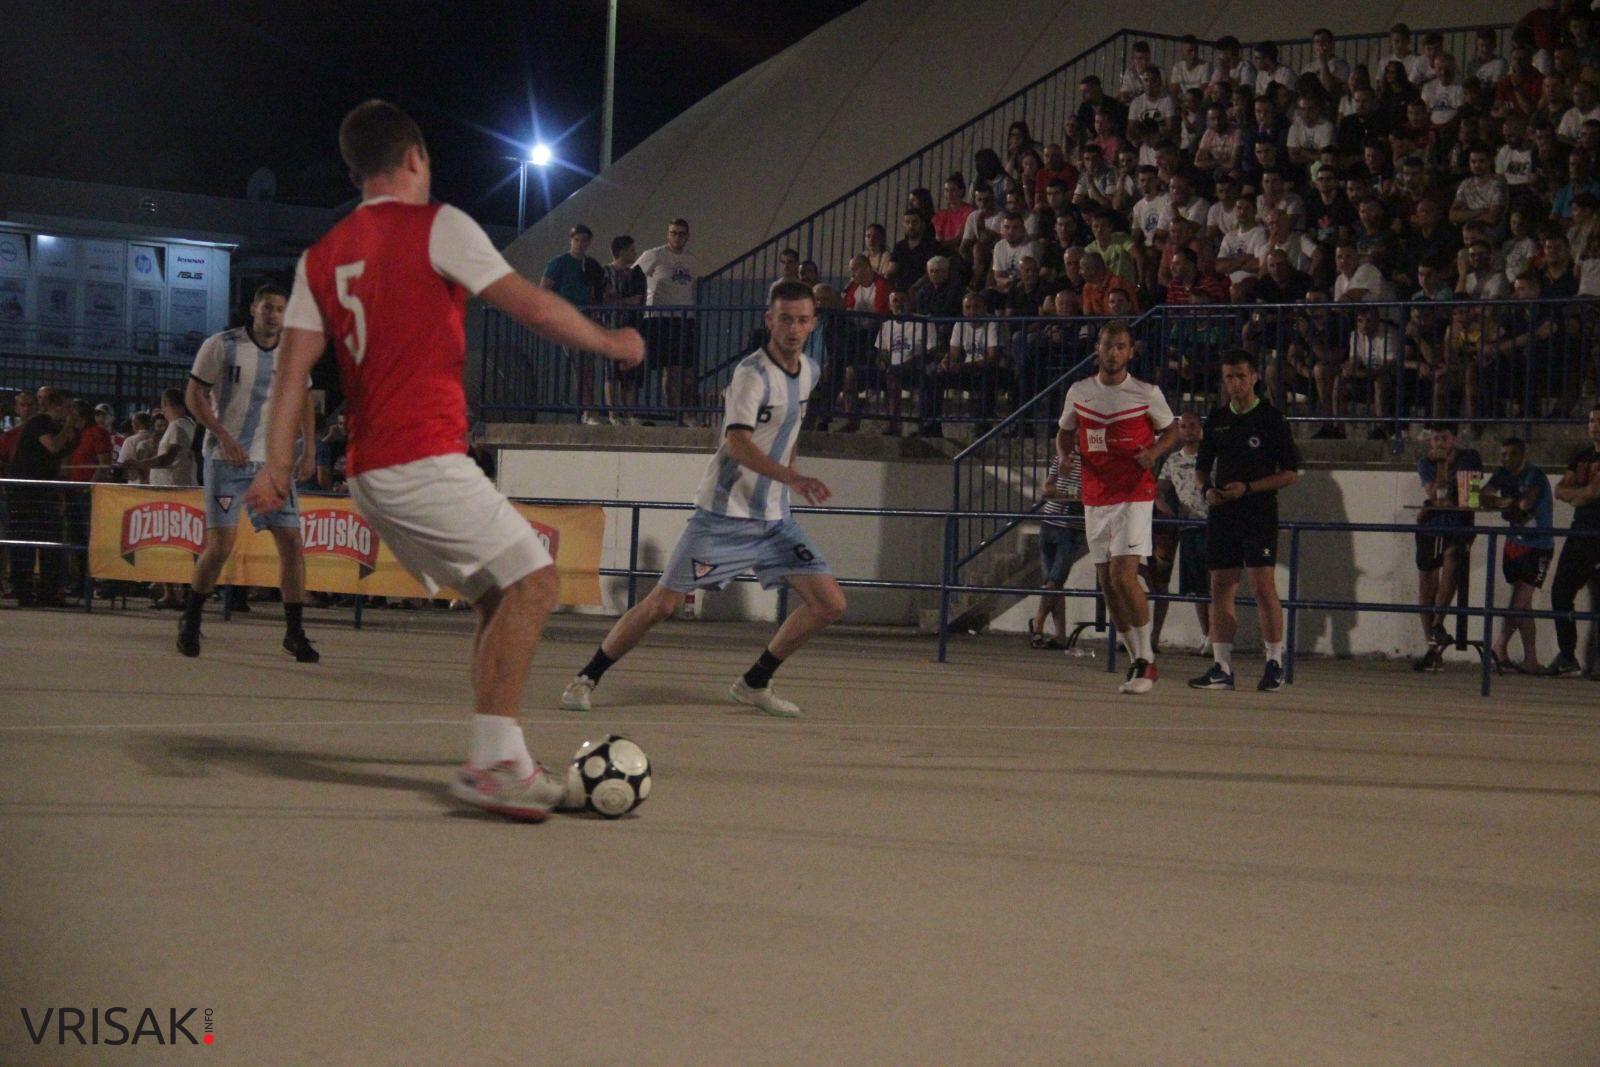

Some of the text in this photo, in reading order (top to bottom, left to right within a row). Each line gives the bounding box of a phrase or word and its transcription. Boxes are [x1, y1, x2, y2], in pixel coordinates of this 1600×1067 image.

[177, 271, 203, 280] ASUS
[335, 260, 366, 364] 5
[229, 365, 241, 383] 11
[757, 405, 774, 423] 6
[129, 505, 204, 546] Ožujsko
[793, 543, 814, 561] 6
